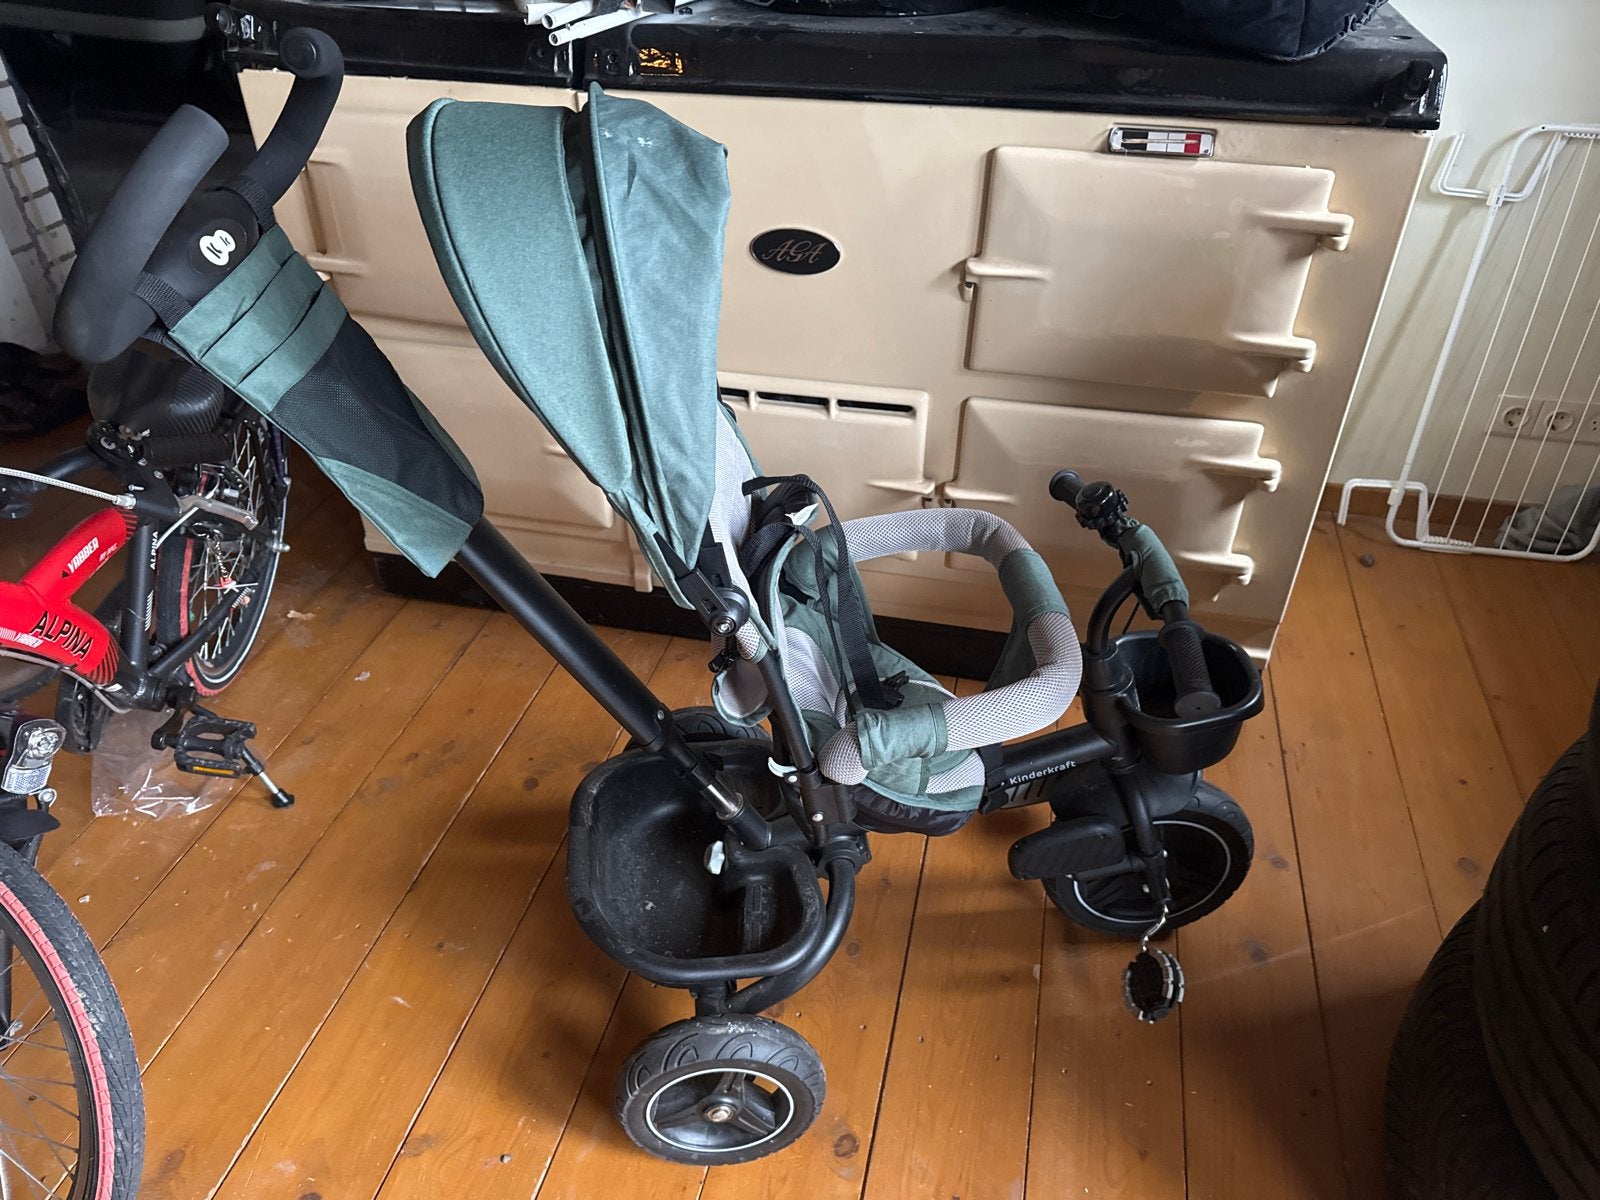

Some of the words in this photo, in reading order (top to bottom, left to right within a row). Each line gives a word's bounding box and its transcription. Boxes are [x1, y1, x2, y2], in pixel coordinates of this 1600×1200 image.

[762, 239, 828, 264] AGA
[150, 530, 159, 571] ALPINA
[29, 611, 94, 661] ALPINA
[1009, 760, 1078, 785] Kinderkraft
